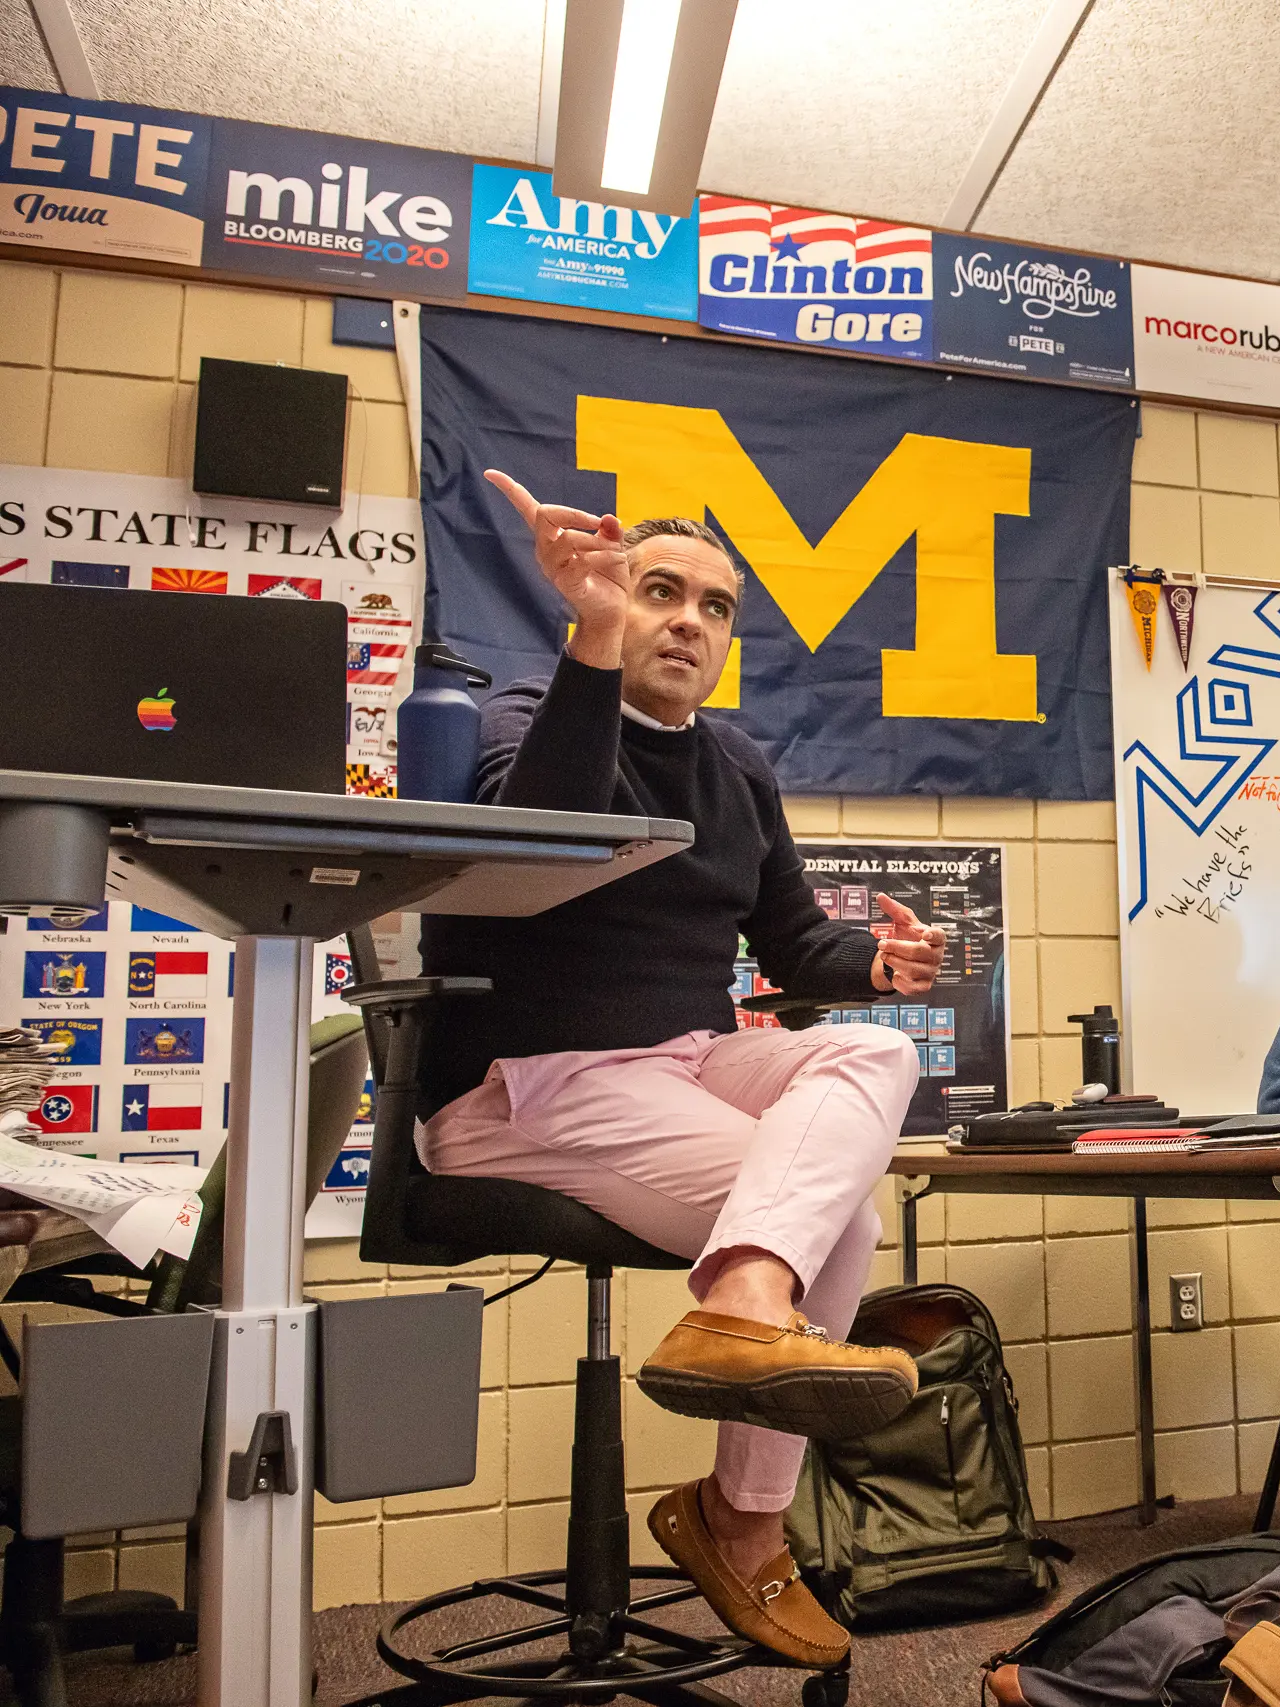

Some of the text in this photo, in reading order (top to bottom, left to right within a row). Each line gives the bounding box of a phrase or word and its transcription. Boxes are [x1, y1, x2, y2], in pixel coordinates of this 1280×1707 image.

[0, 106, 194, 196] ETE
[14, 193, 108, 226] Iowa
[226, 162, 453, 243] mike
[486, 178, 681, 259] Amy
[224, 221, 363, 252] BLOOMBERG
[364, 239, 449, 270] 2020
[526, 234, 631, 260] for AMERICA
[555, 258, 588, 273] Amy
[709, 254, 924, 294] Clinton
[796, 304, 922, 342] Gore
[1022, 338, 1052, 351] PETE
[940, 352, 1027, 371] PeteForAmerica.com
[1205, 346, 1225, 356] NEW
[1228, 350, 1270, 363] AMERICAN
[44, 505, 416, 565] STATE FLAGS
[568, 395, 1038, 722] M
[353, 627, 399, 638] California
[353, 687, 393, 698] Georgia
[803, 859, 980, 875] DENTIAL ELECTIONS
[42, 933, 92, 944] Nebraska
[152, 935, 190, 944] Nevada
[38, 1001, 91, 1011] New York
[129, 1001, 207, 1011] North Carolina
[133, 1067, 201, 1078] Pennsylvania
[36, 1138, 84, 1147] ennessee
[148, 1135, 180, 1144] Texas
